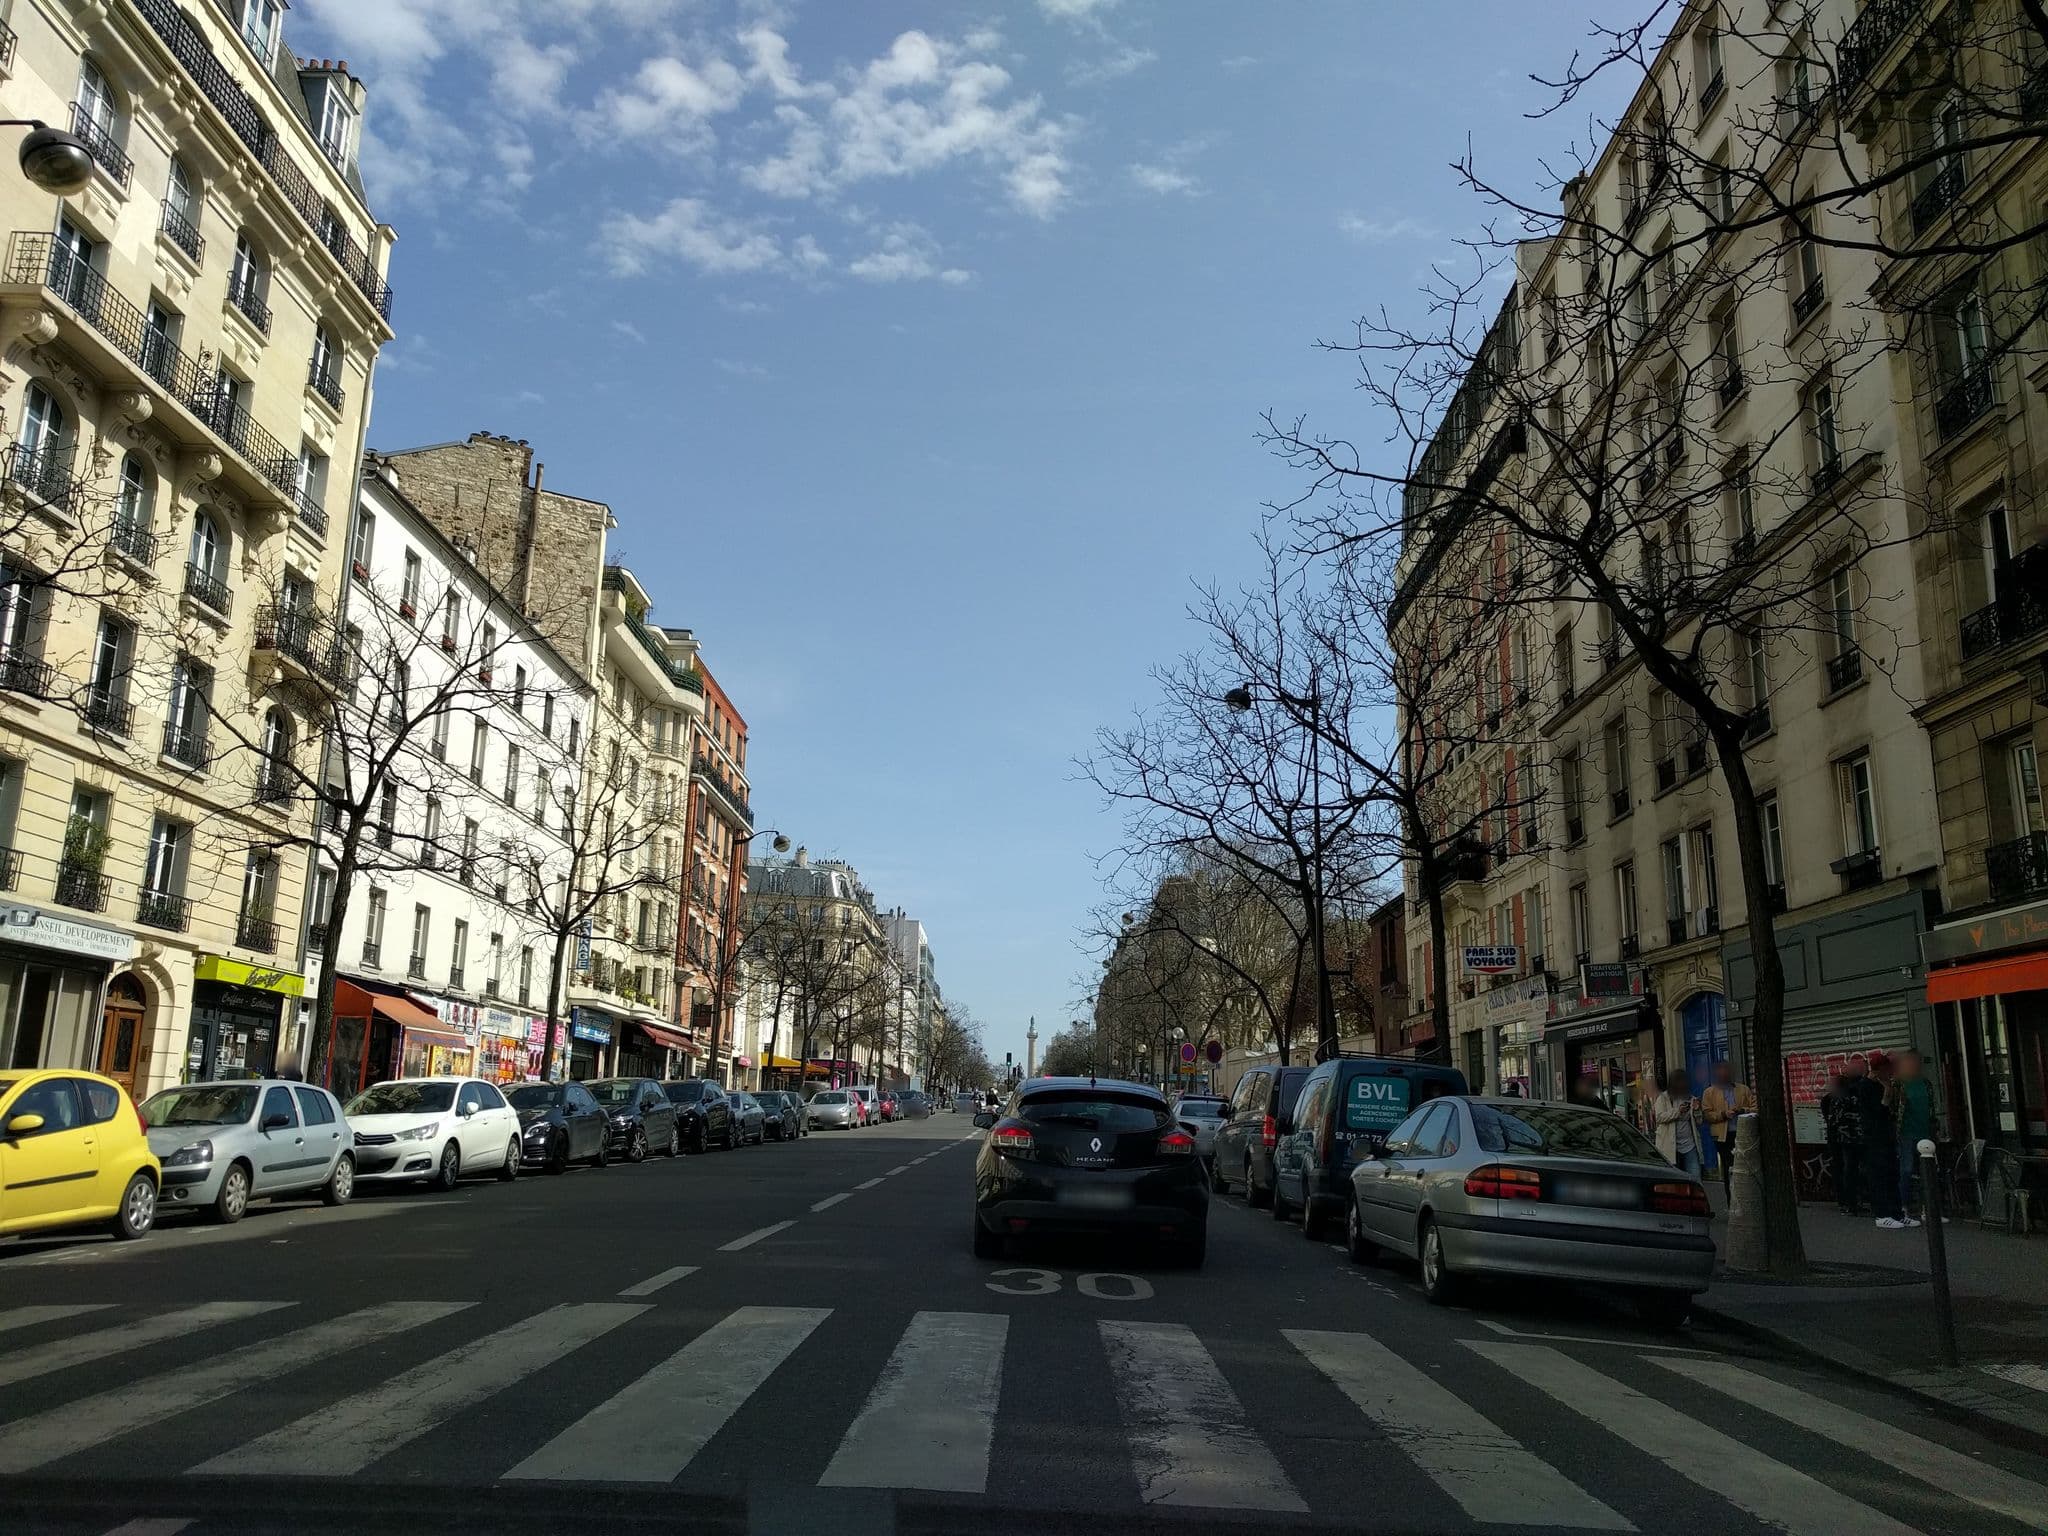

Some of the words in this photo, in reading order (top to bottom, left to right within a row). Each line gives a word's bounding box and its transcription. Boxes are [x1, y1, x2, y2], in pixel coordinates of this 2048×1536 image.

[65, 925, 130, 948] DEVELOPPEMENT
[1465, 947, 1494, 957] PARIS
[1496, 947, 1517, 956] SUD
[1466, 957, 1517, 967] VOYAGES
[1357, 1082, 1401, 1101] BVL
[1346, 1132, 1356, 1140] 01
[1371, 1134, 1383, 1143] 72
[985, 1268, 1155, 1301] 30
